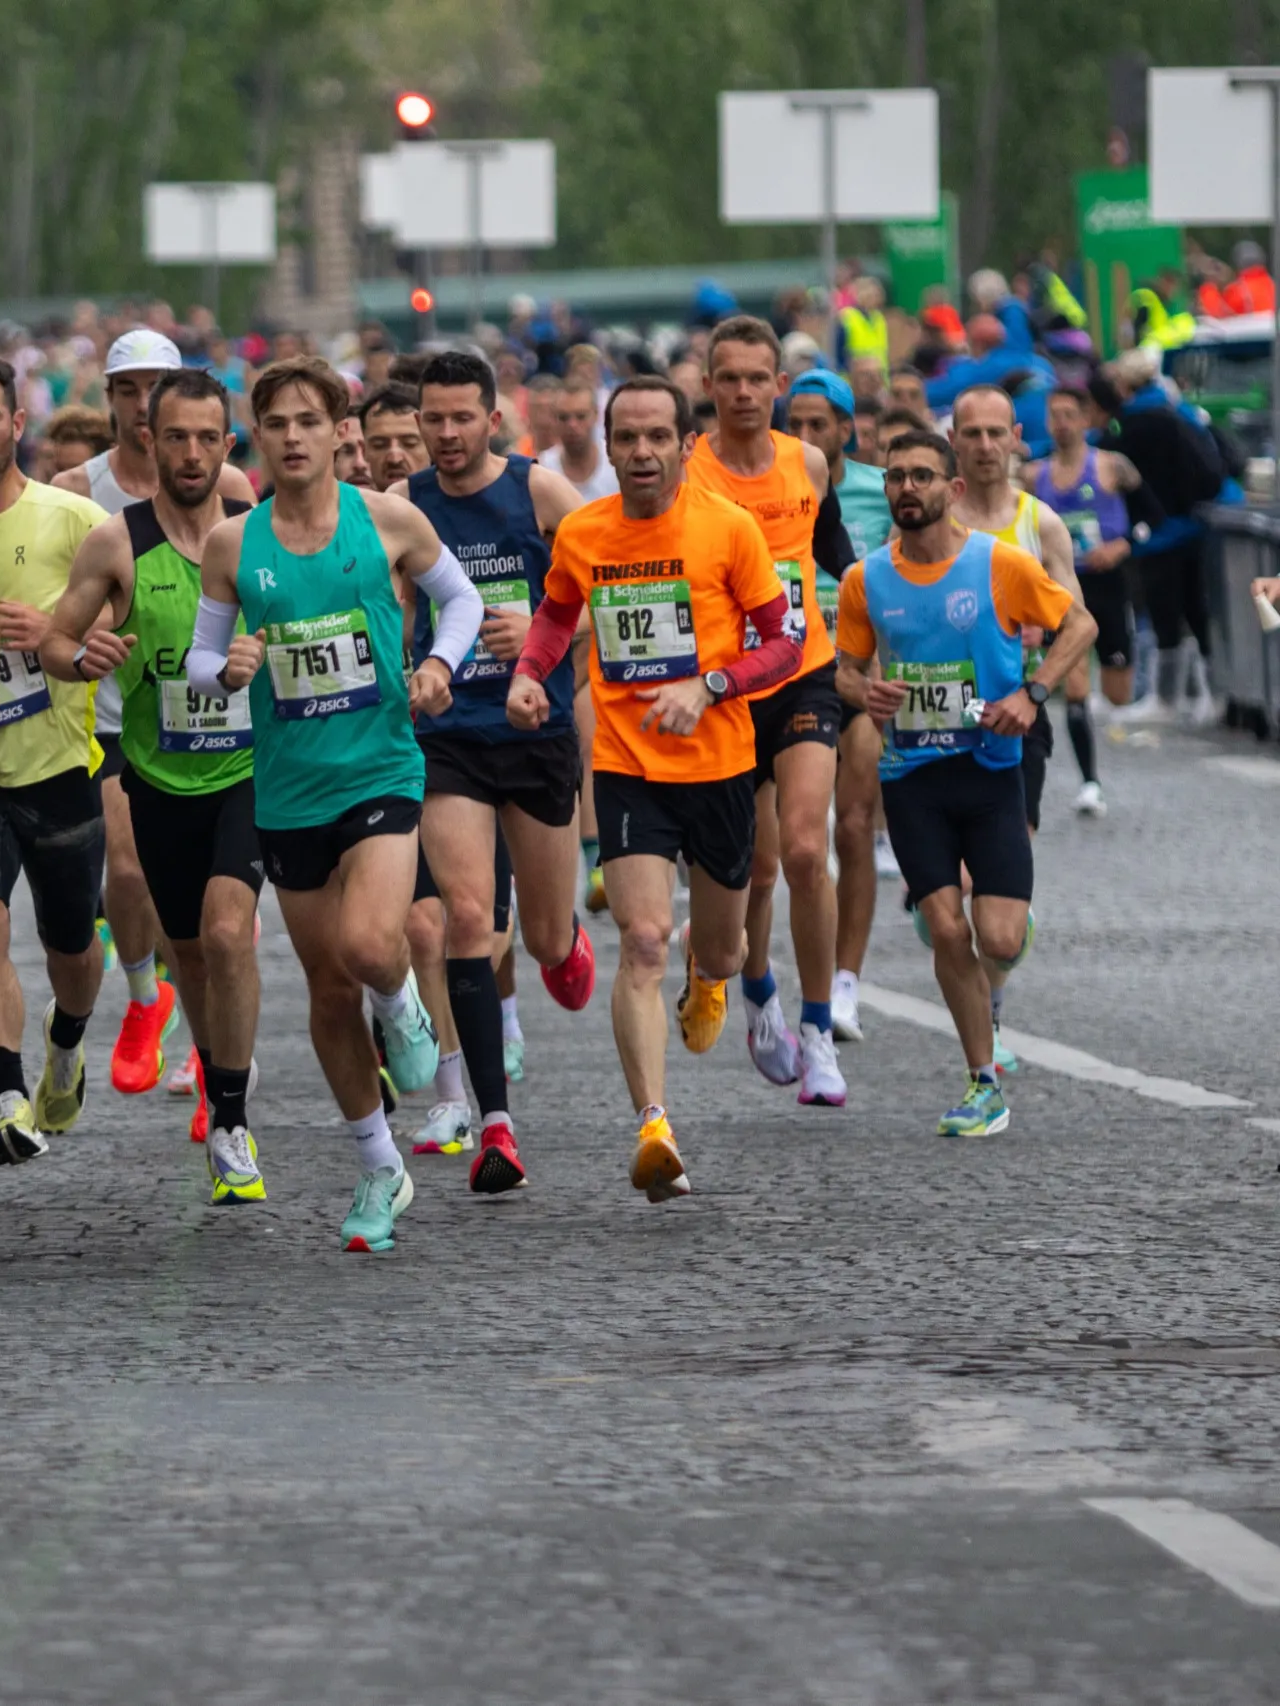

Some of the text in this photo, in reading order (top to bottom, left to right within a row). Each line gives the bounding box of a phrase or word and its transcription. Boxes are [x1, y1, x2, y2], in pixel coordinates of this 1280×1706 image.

[457, 543, 496, 558] tonton
[592, 559, 684, 582] FINISHER
[614, 582, 677, 598] Schneider
[285, 614, 352, 634] Schneider
[617, 608, 655, 641] 812
[286, 641, 341, 678] 7151
[477, 662, 507, 676] asics
[637, 663, 668, 677] asics
[318, 696, 351, 713] asics
[906, 685, 950, 713] 7142
[205, 736, 237, 748] asics
